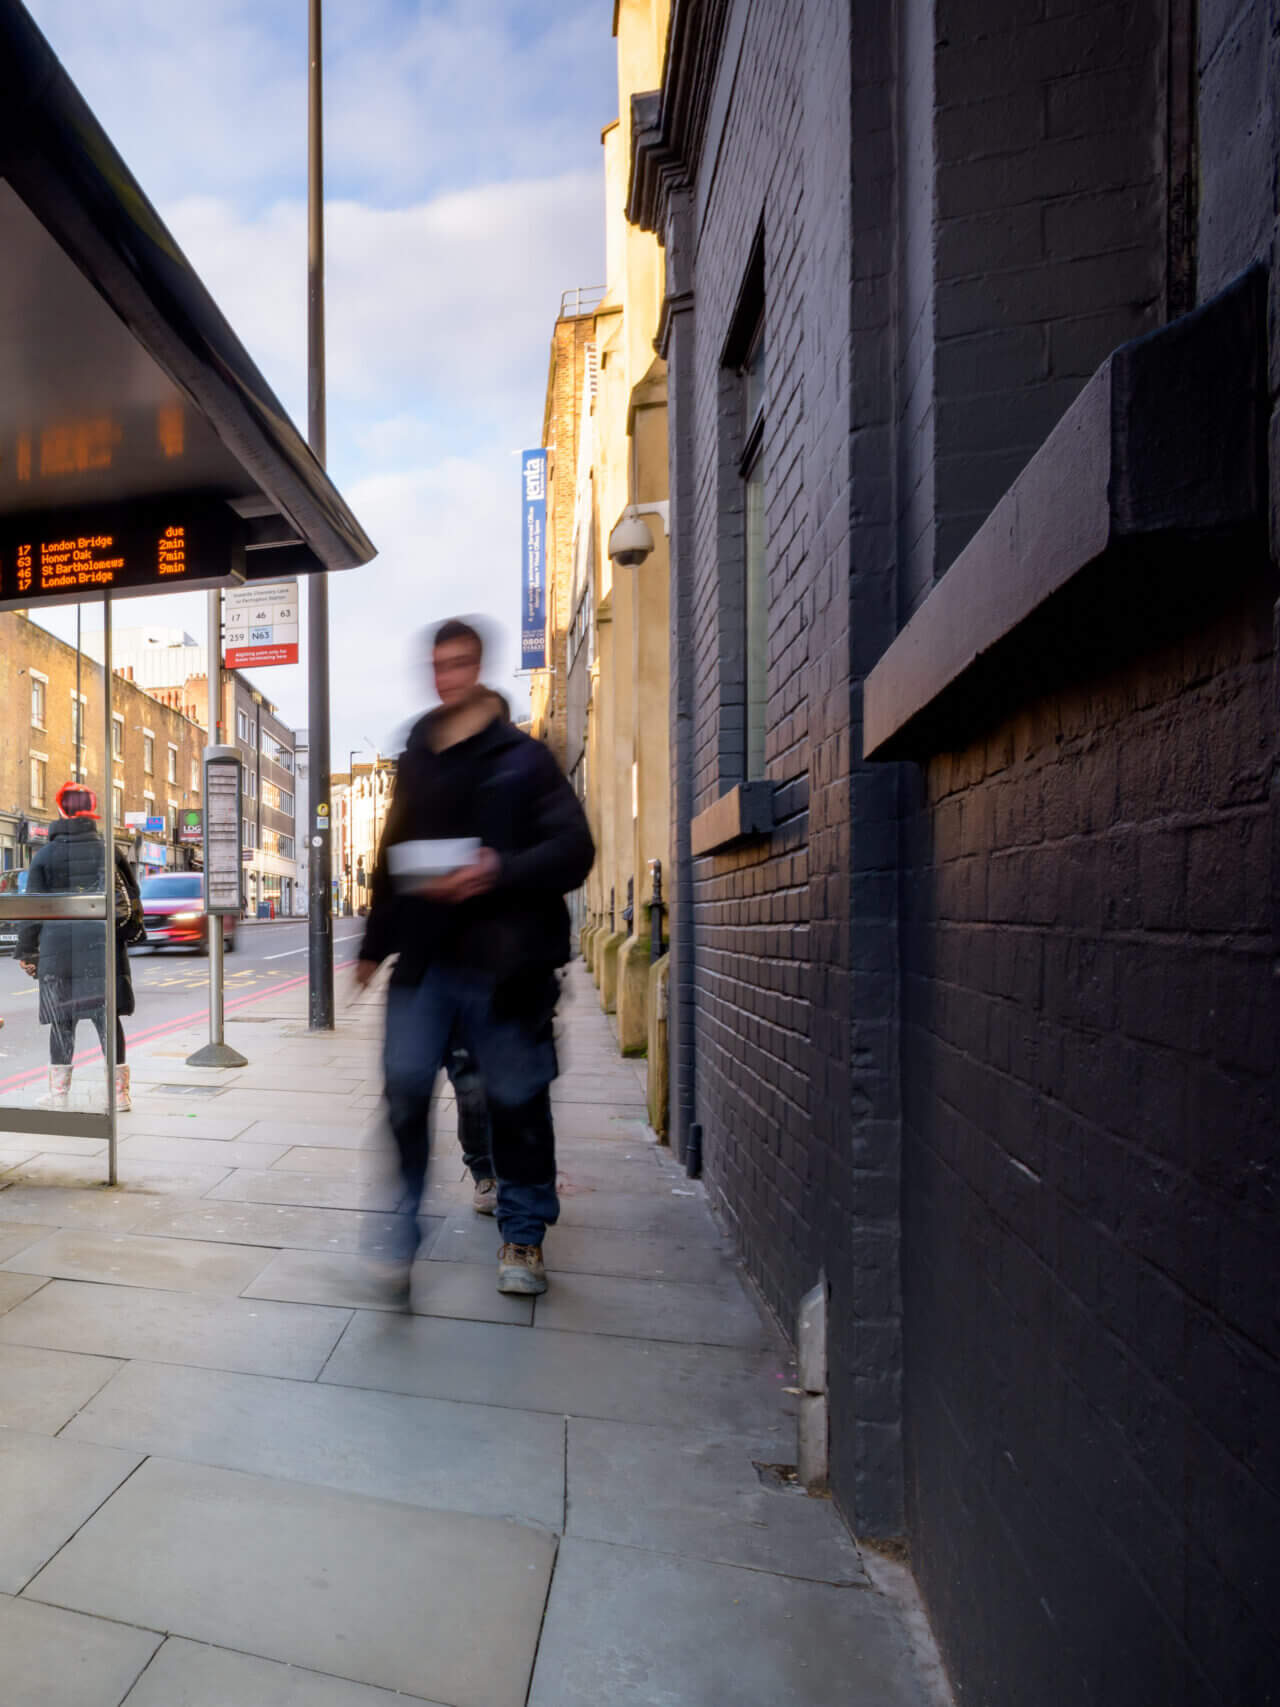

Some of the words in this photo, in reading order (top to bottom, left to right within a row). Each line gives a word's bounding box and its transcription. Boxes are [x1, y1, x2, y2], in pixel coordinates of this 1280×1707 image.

[17, 557, 32, 568] 63
[41, 553, 71, 565] Honor
[73, 550, 92, 561] Oak
[158, 539, 185, 550] 2min
[18, 545, 31, 556] 17
[41, 539, 76, 553] London
[78, 536, 113, 550] Bridge
[165, 526, 185, 538] due
[17, 569, 32, 579] 46
[41, 565, 54, 577] St
[55, 558, 124, 574] Bartholomews
[158, 551, 185, 562] 7min
[18, 579, 32, 591] 17
[41, 575, 76, 588] London
[78, 571, 113, 584] Bridge
[158, 563, 185, 575] 9min
[231, 613, 241, 622] 17
[255, 611, 266, 619] 46
[280, 608, 291, 618] 63
[229, 633, 245, 642] 259
[252, 631, 270, 641] N63
